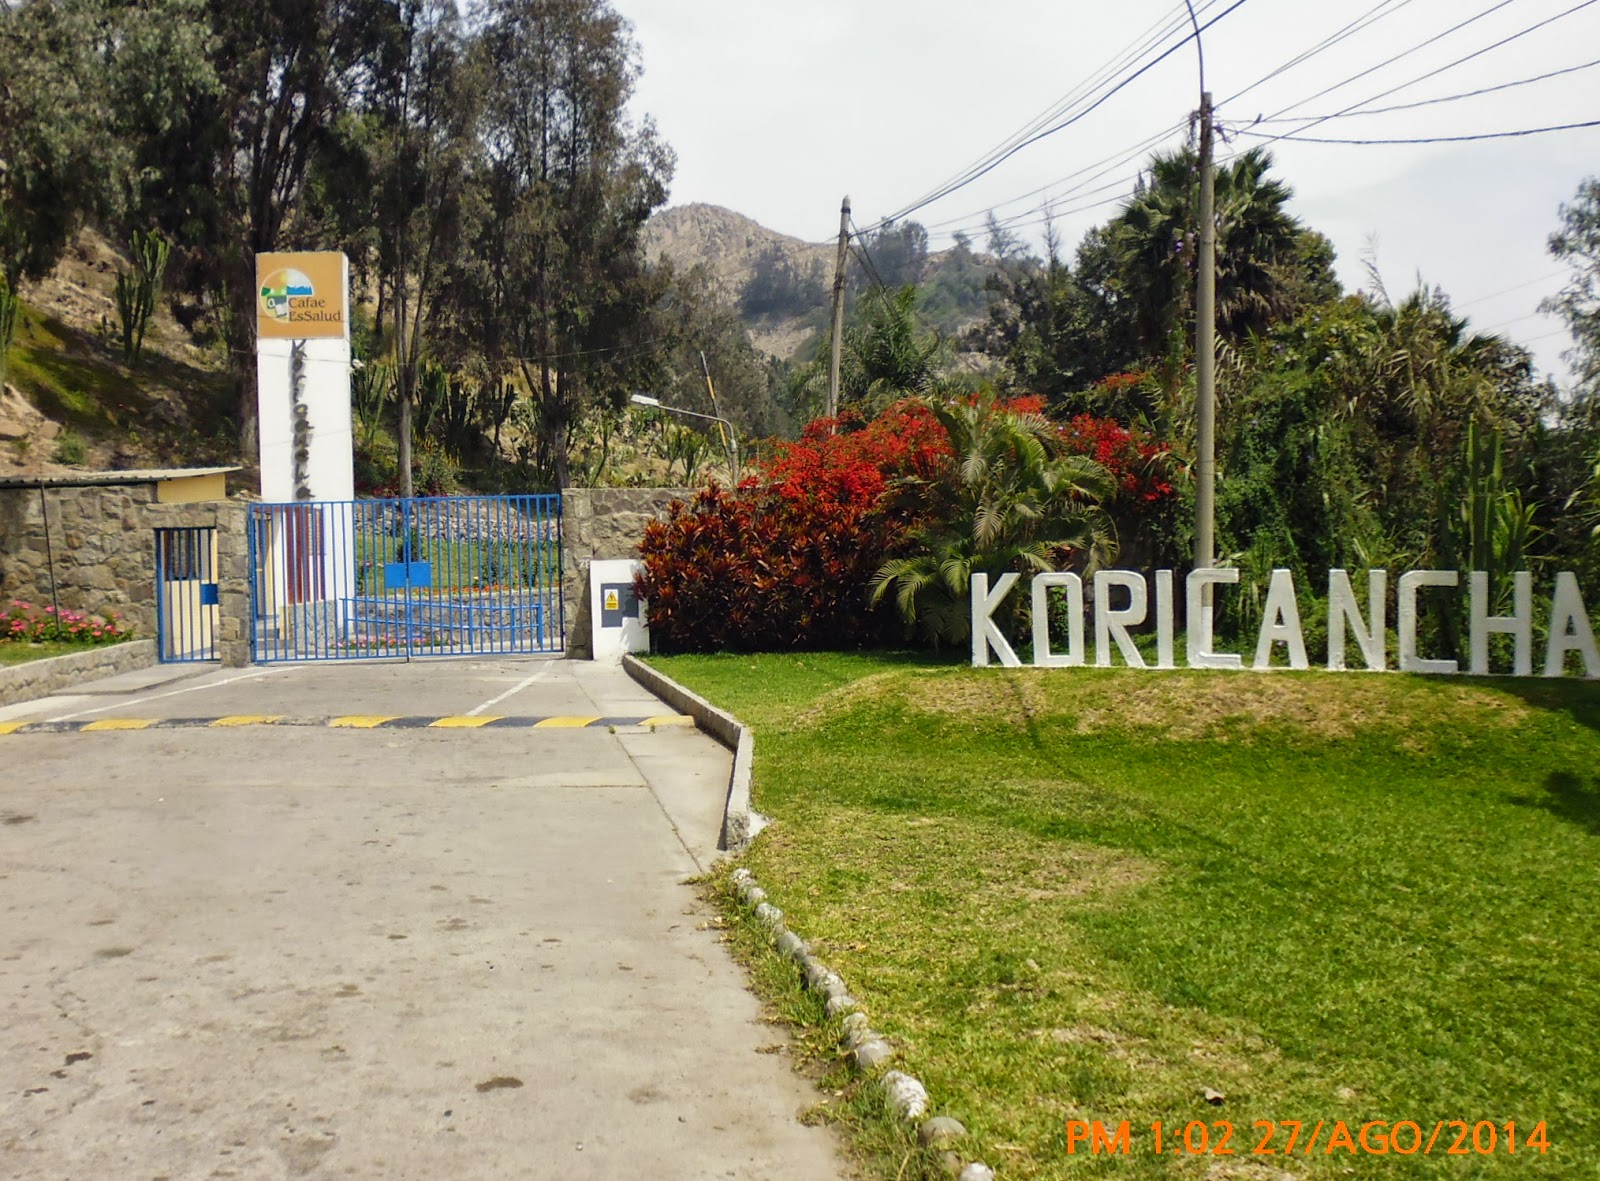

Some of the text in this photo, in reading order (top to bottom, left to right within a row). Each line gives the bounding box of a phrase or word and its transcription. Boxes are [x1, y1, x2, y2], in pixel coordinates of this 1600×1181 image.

[288, 297, 326, 308] Cafae
[288, 310, 341, 322] EsSalud
[971, 568, 1600, 678] KORICANCHA
